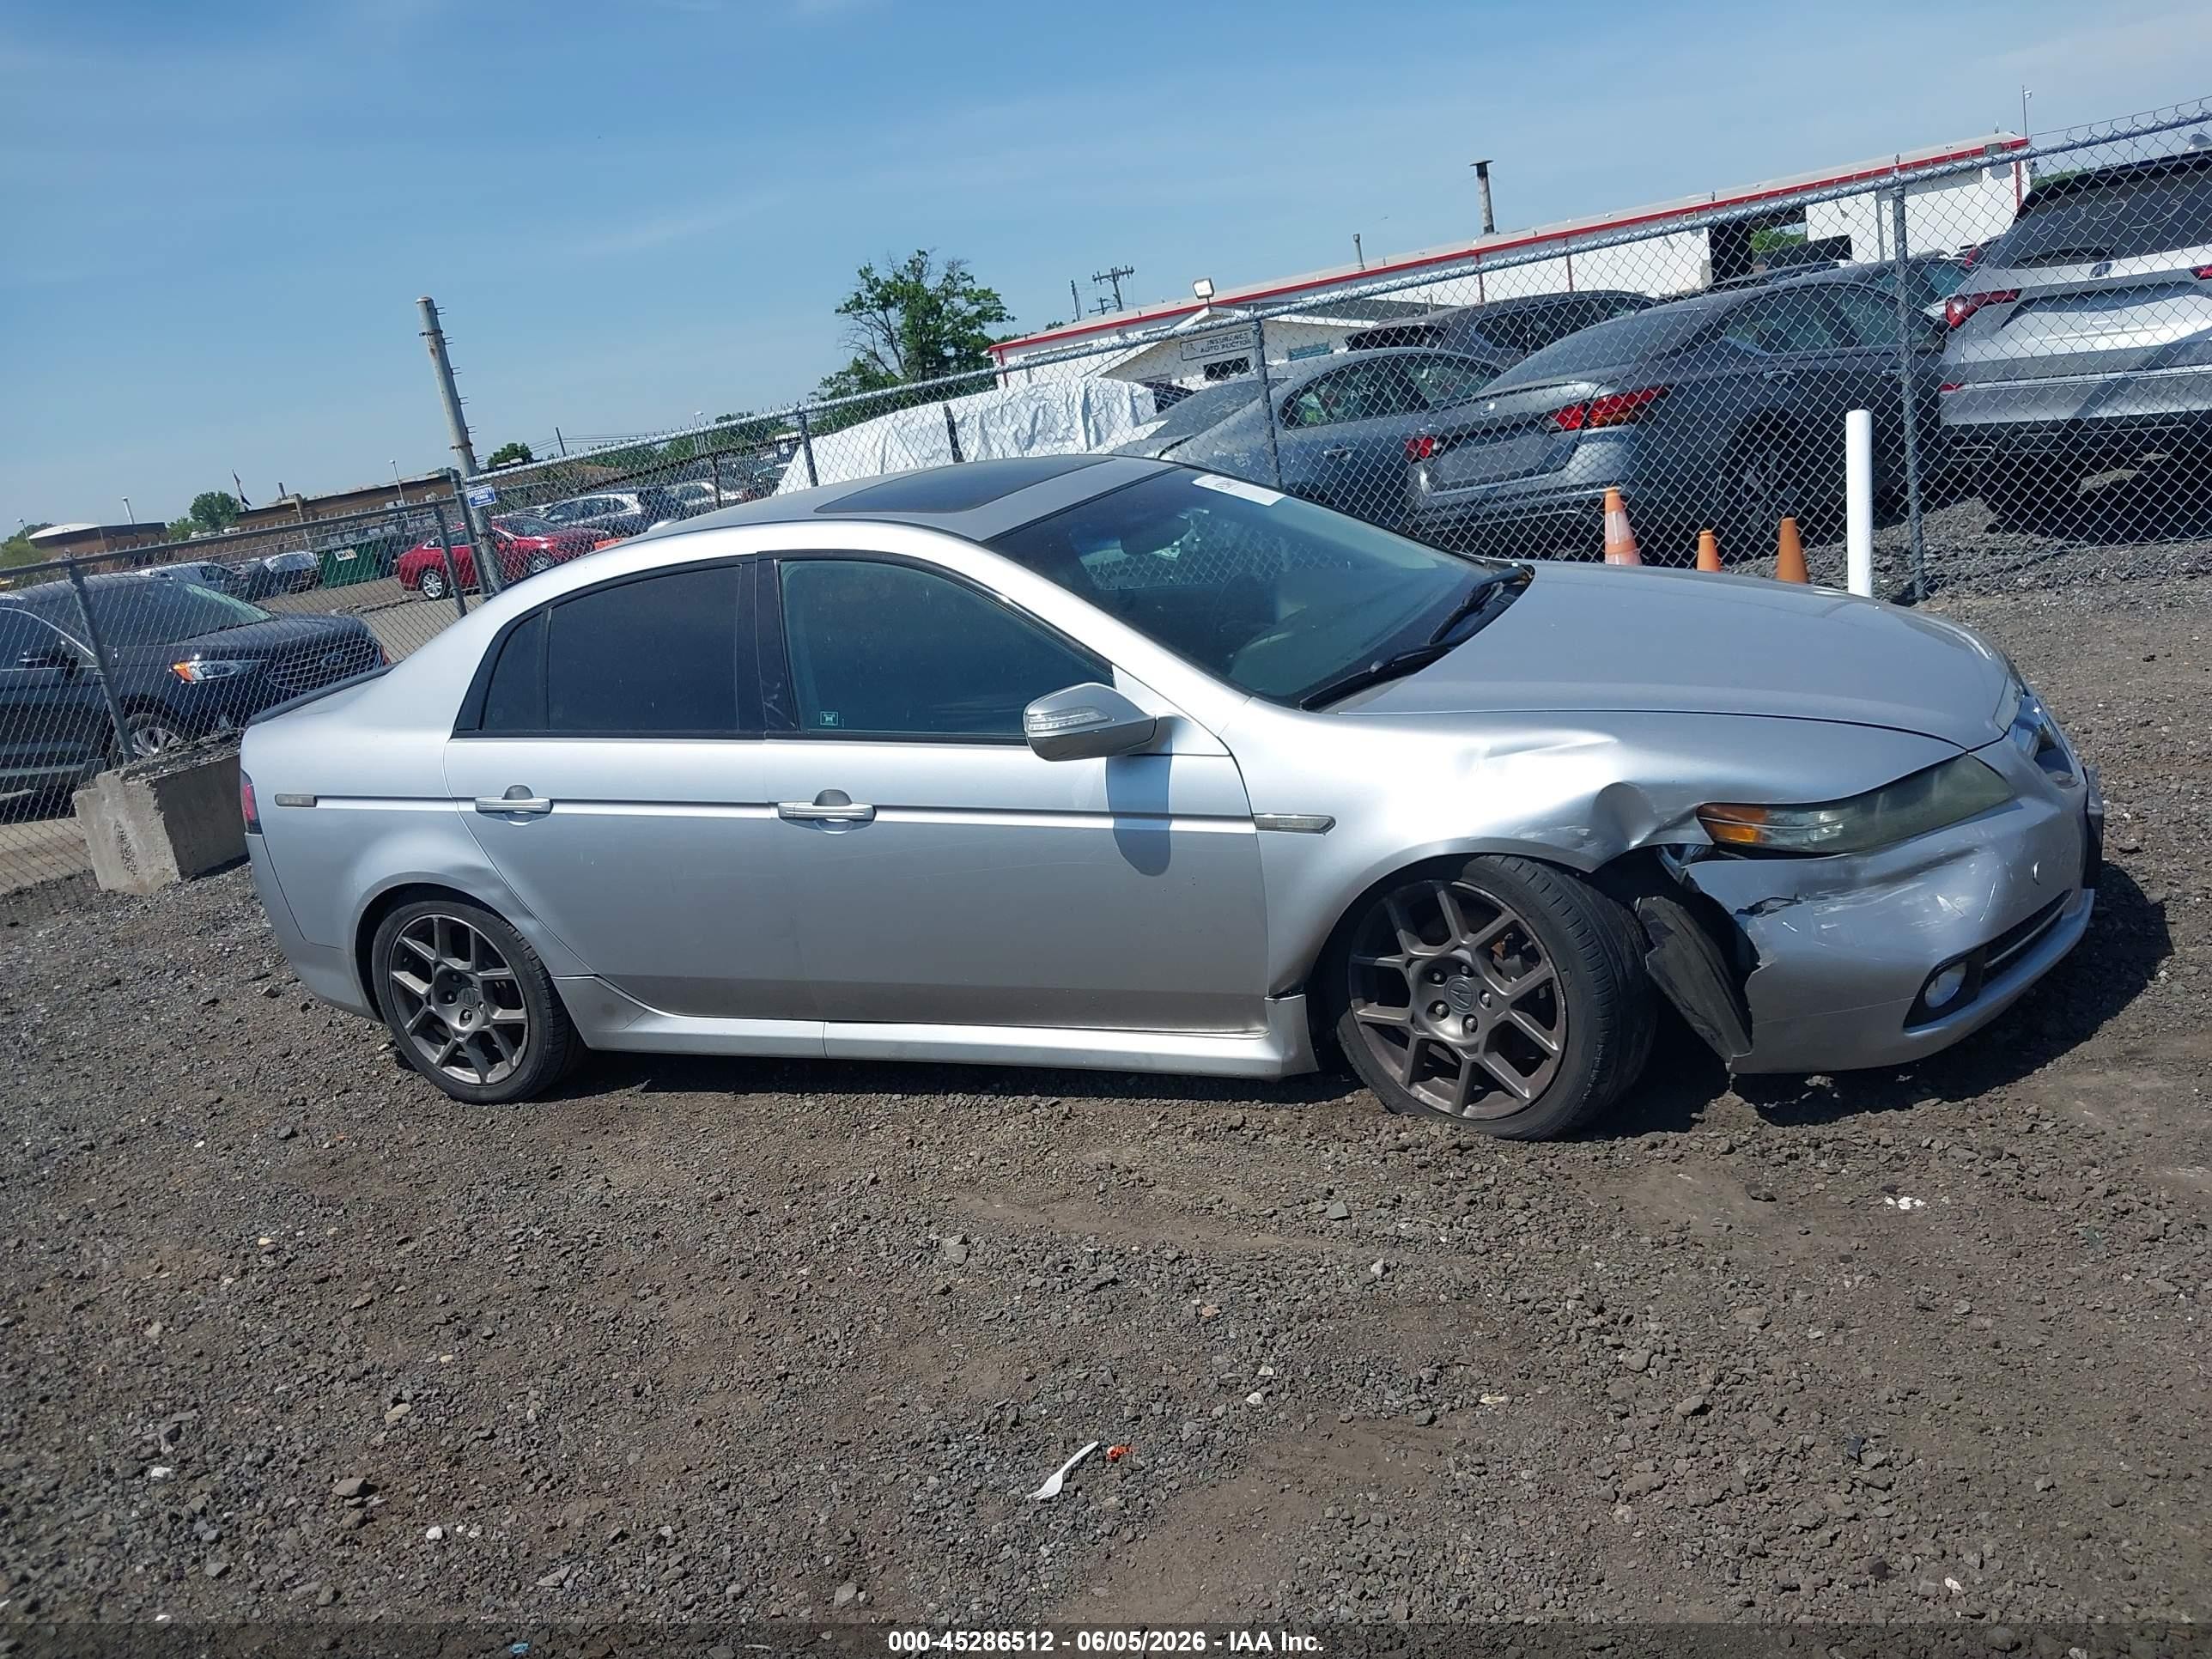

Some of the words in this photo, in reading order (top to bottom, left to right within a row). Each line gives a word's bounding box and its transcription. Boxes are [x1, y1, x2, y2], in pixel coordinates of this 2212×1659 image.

[1206, 331, 1248, 346] INSURANCE
[1200, 343, 1219, 353] AUTO
[467, 486, 493, 499] SECURITY
